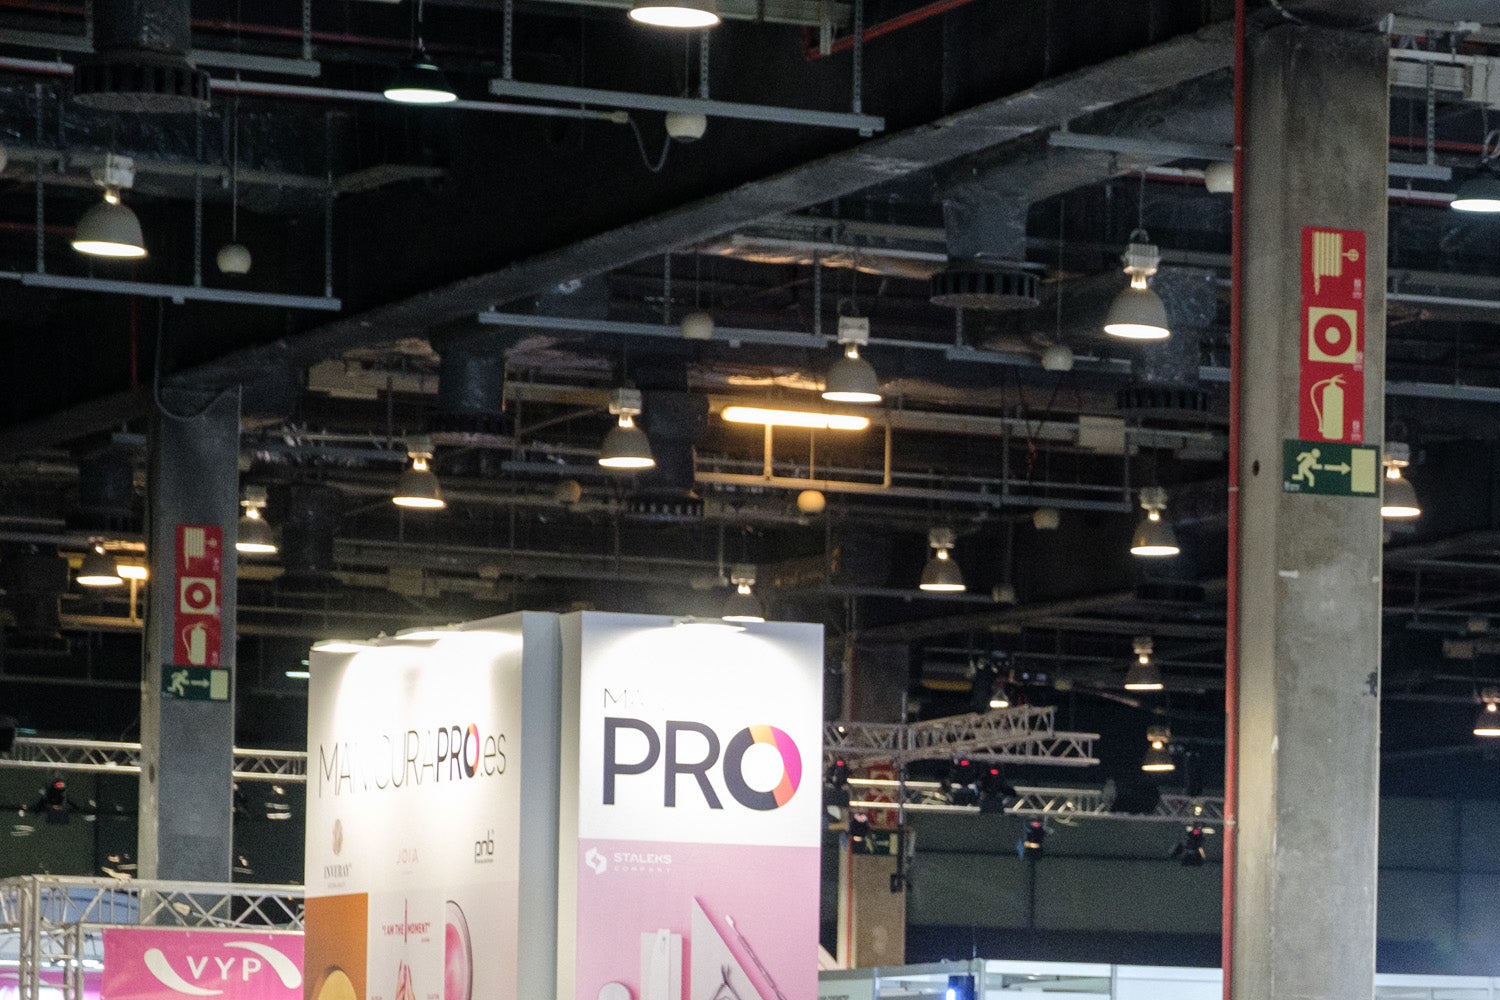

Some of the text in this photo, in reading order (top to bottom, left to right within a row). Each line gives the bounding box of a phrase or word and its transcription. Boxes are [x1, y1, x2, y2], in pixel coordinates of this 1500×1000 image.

[603, 716, 803, 812] PRO
[613, 853, 673, 865] STALEKS
[186, 955, 262, 981] VYP
